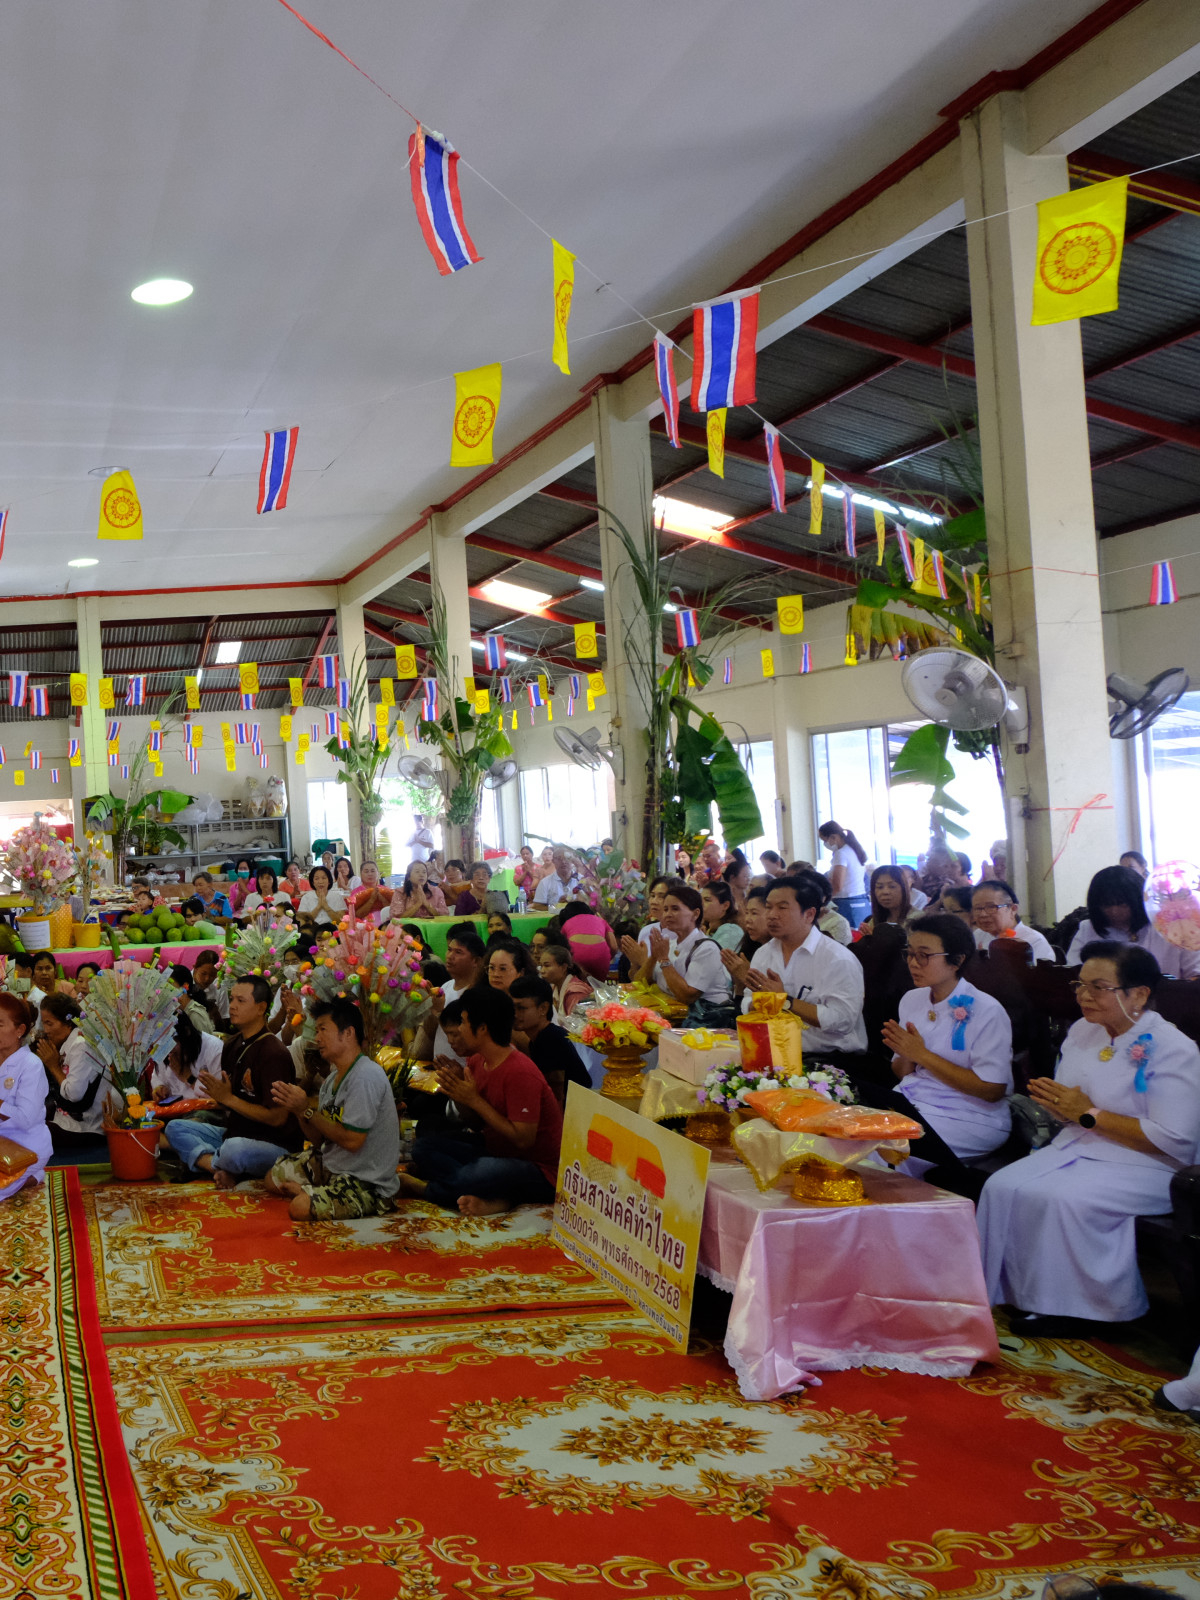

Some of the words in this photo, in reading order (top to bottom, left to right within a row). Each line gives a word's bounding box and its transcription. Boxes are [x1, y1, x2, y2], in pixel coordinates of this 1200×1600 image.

[560, 1203, 599, 1247] 30,000วัด
[601, 1235, 651, 1287] พุทธศักราช
[653, 1274, 680, 1311] 2568
[563, 1161, 685, 1270] กฐินสามัคคีทั่วไทย
